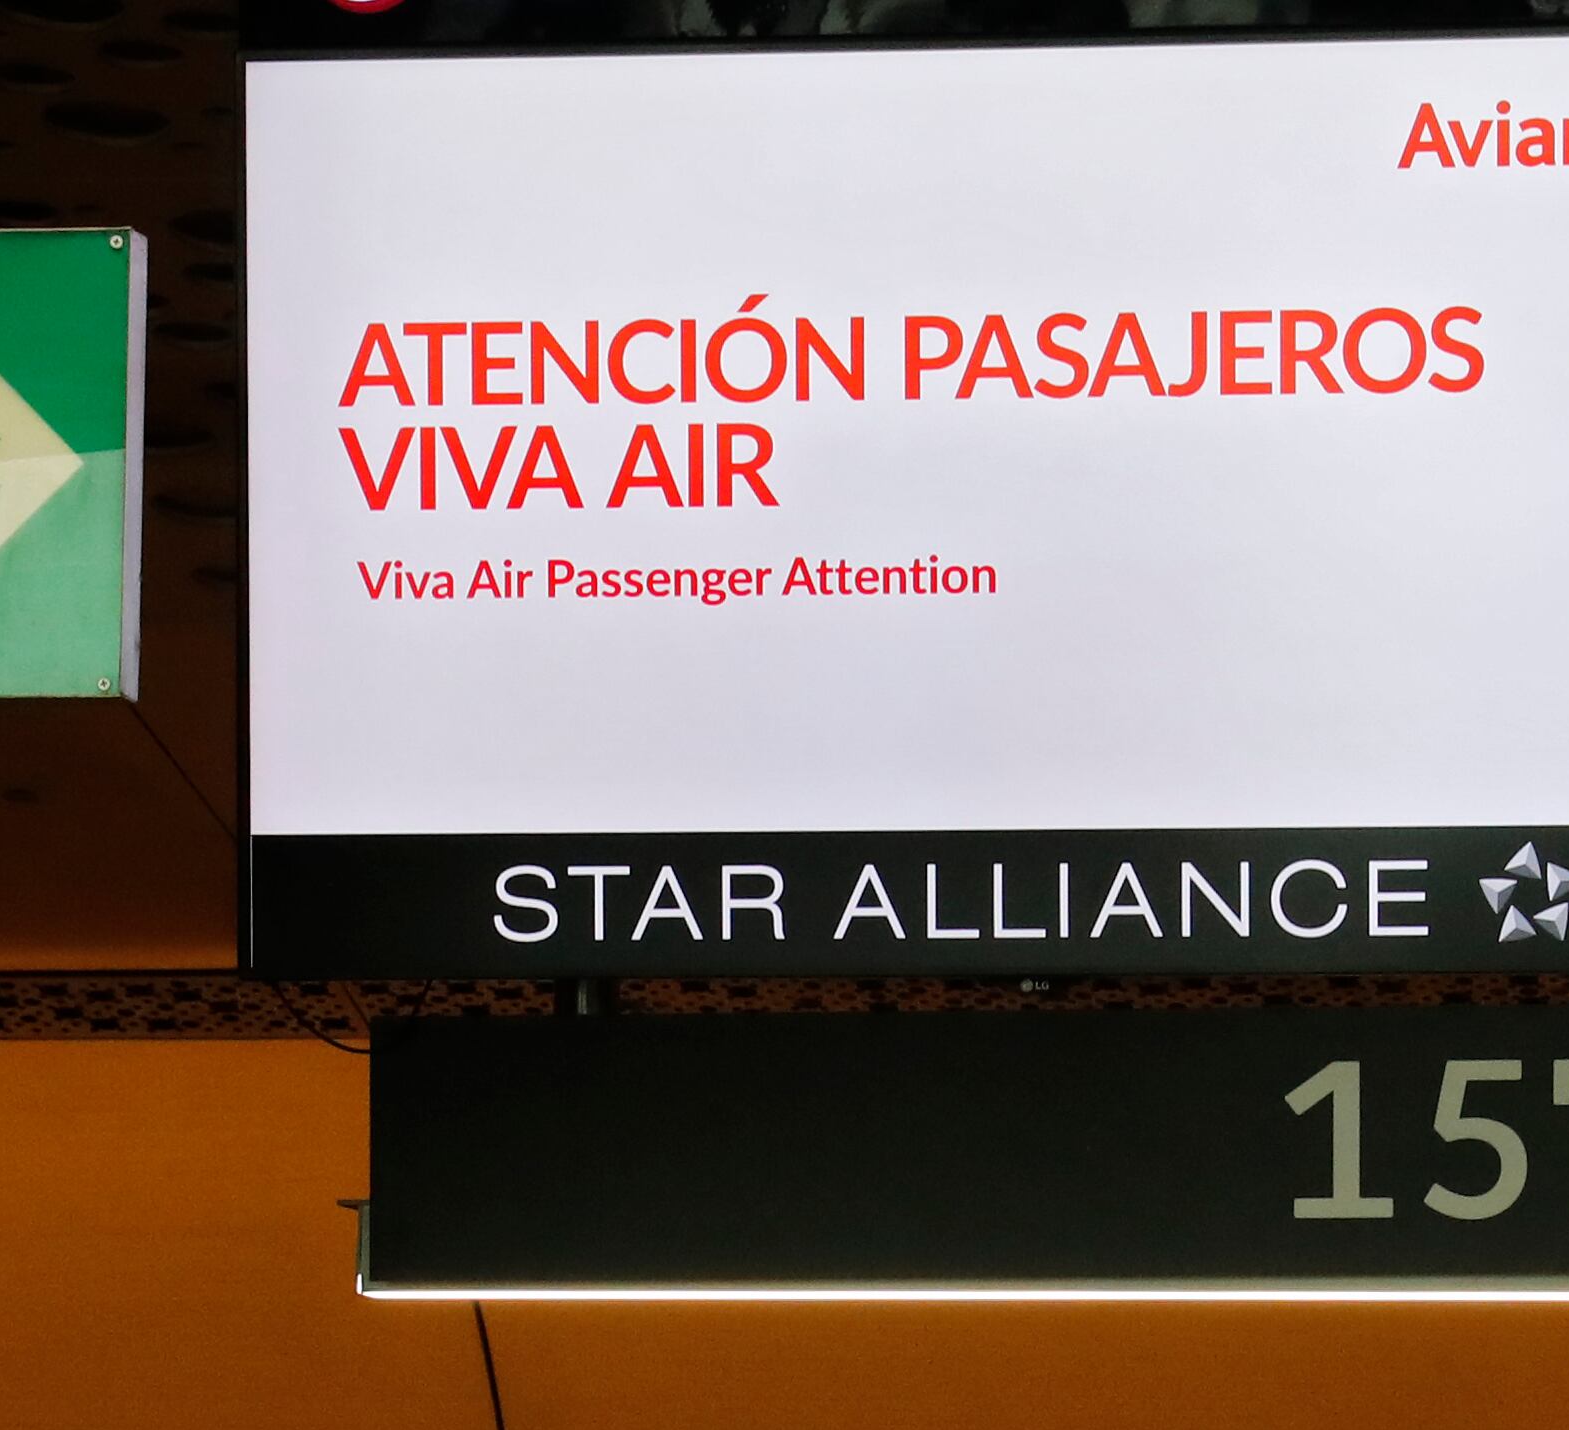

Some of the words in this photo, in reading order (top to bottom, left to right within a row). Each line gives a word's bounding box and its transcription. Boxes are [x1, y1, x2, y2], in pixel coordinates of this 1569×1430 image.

[338, 293, 865, 408] ATENCIÓN
[903, 306, 1486, 401] PASAJEROS
[338, 424, 584, 511] VIVA
[606, 422, 781, 509] AIR
[357, 560, 455, 600] Viva
[468, 559, 534, 599] Air
[547, 558, 773, 607] Passenger
[782, 554, 998, 597] Attention
[493, 864, 786, 943] STAR
[833, 859, 1430, 941] ALLIANCE
[1035, 981, 1049, 991] LG
